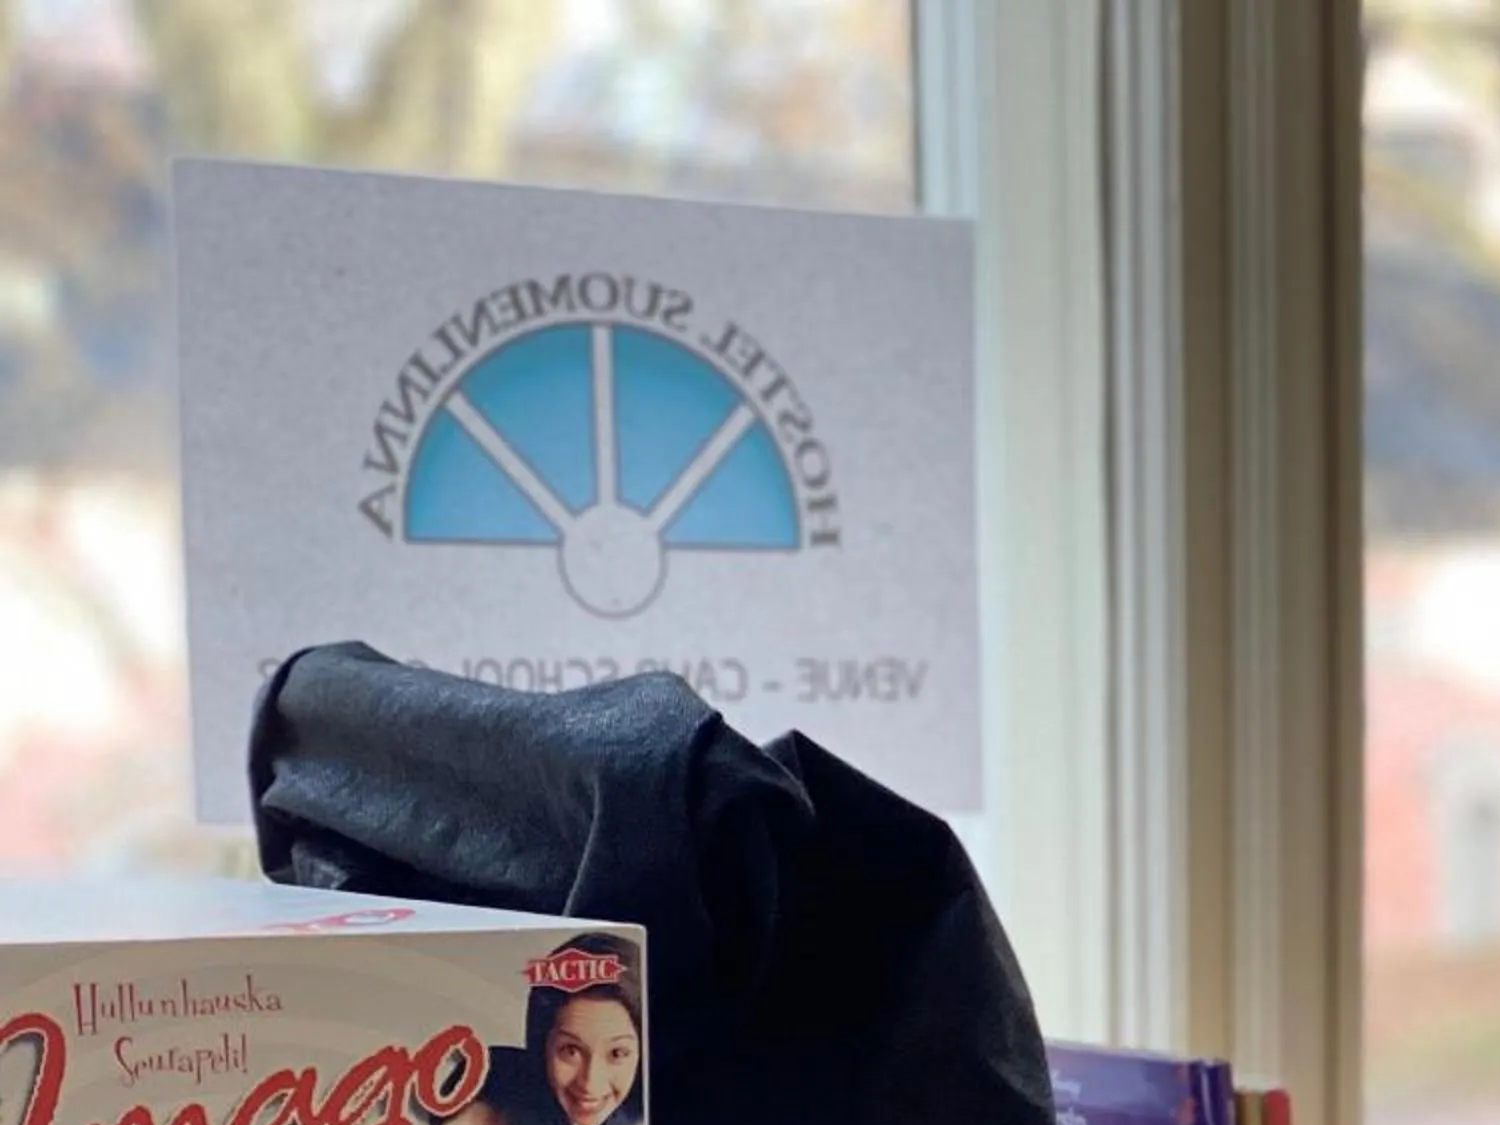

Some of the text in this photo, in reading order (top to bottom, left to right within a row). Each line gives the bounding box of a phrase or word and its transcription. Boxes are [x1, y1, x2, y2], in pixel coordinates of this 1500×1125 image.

[529, 958, 617, 984] TACTIC
[74, 975, 283, 1036] Hullunhauska
[114, 1033, 249, 1087] Seurapeli!
